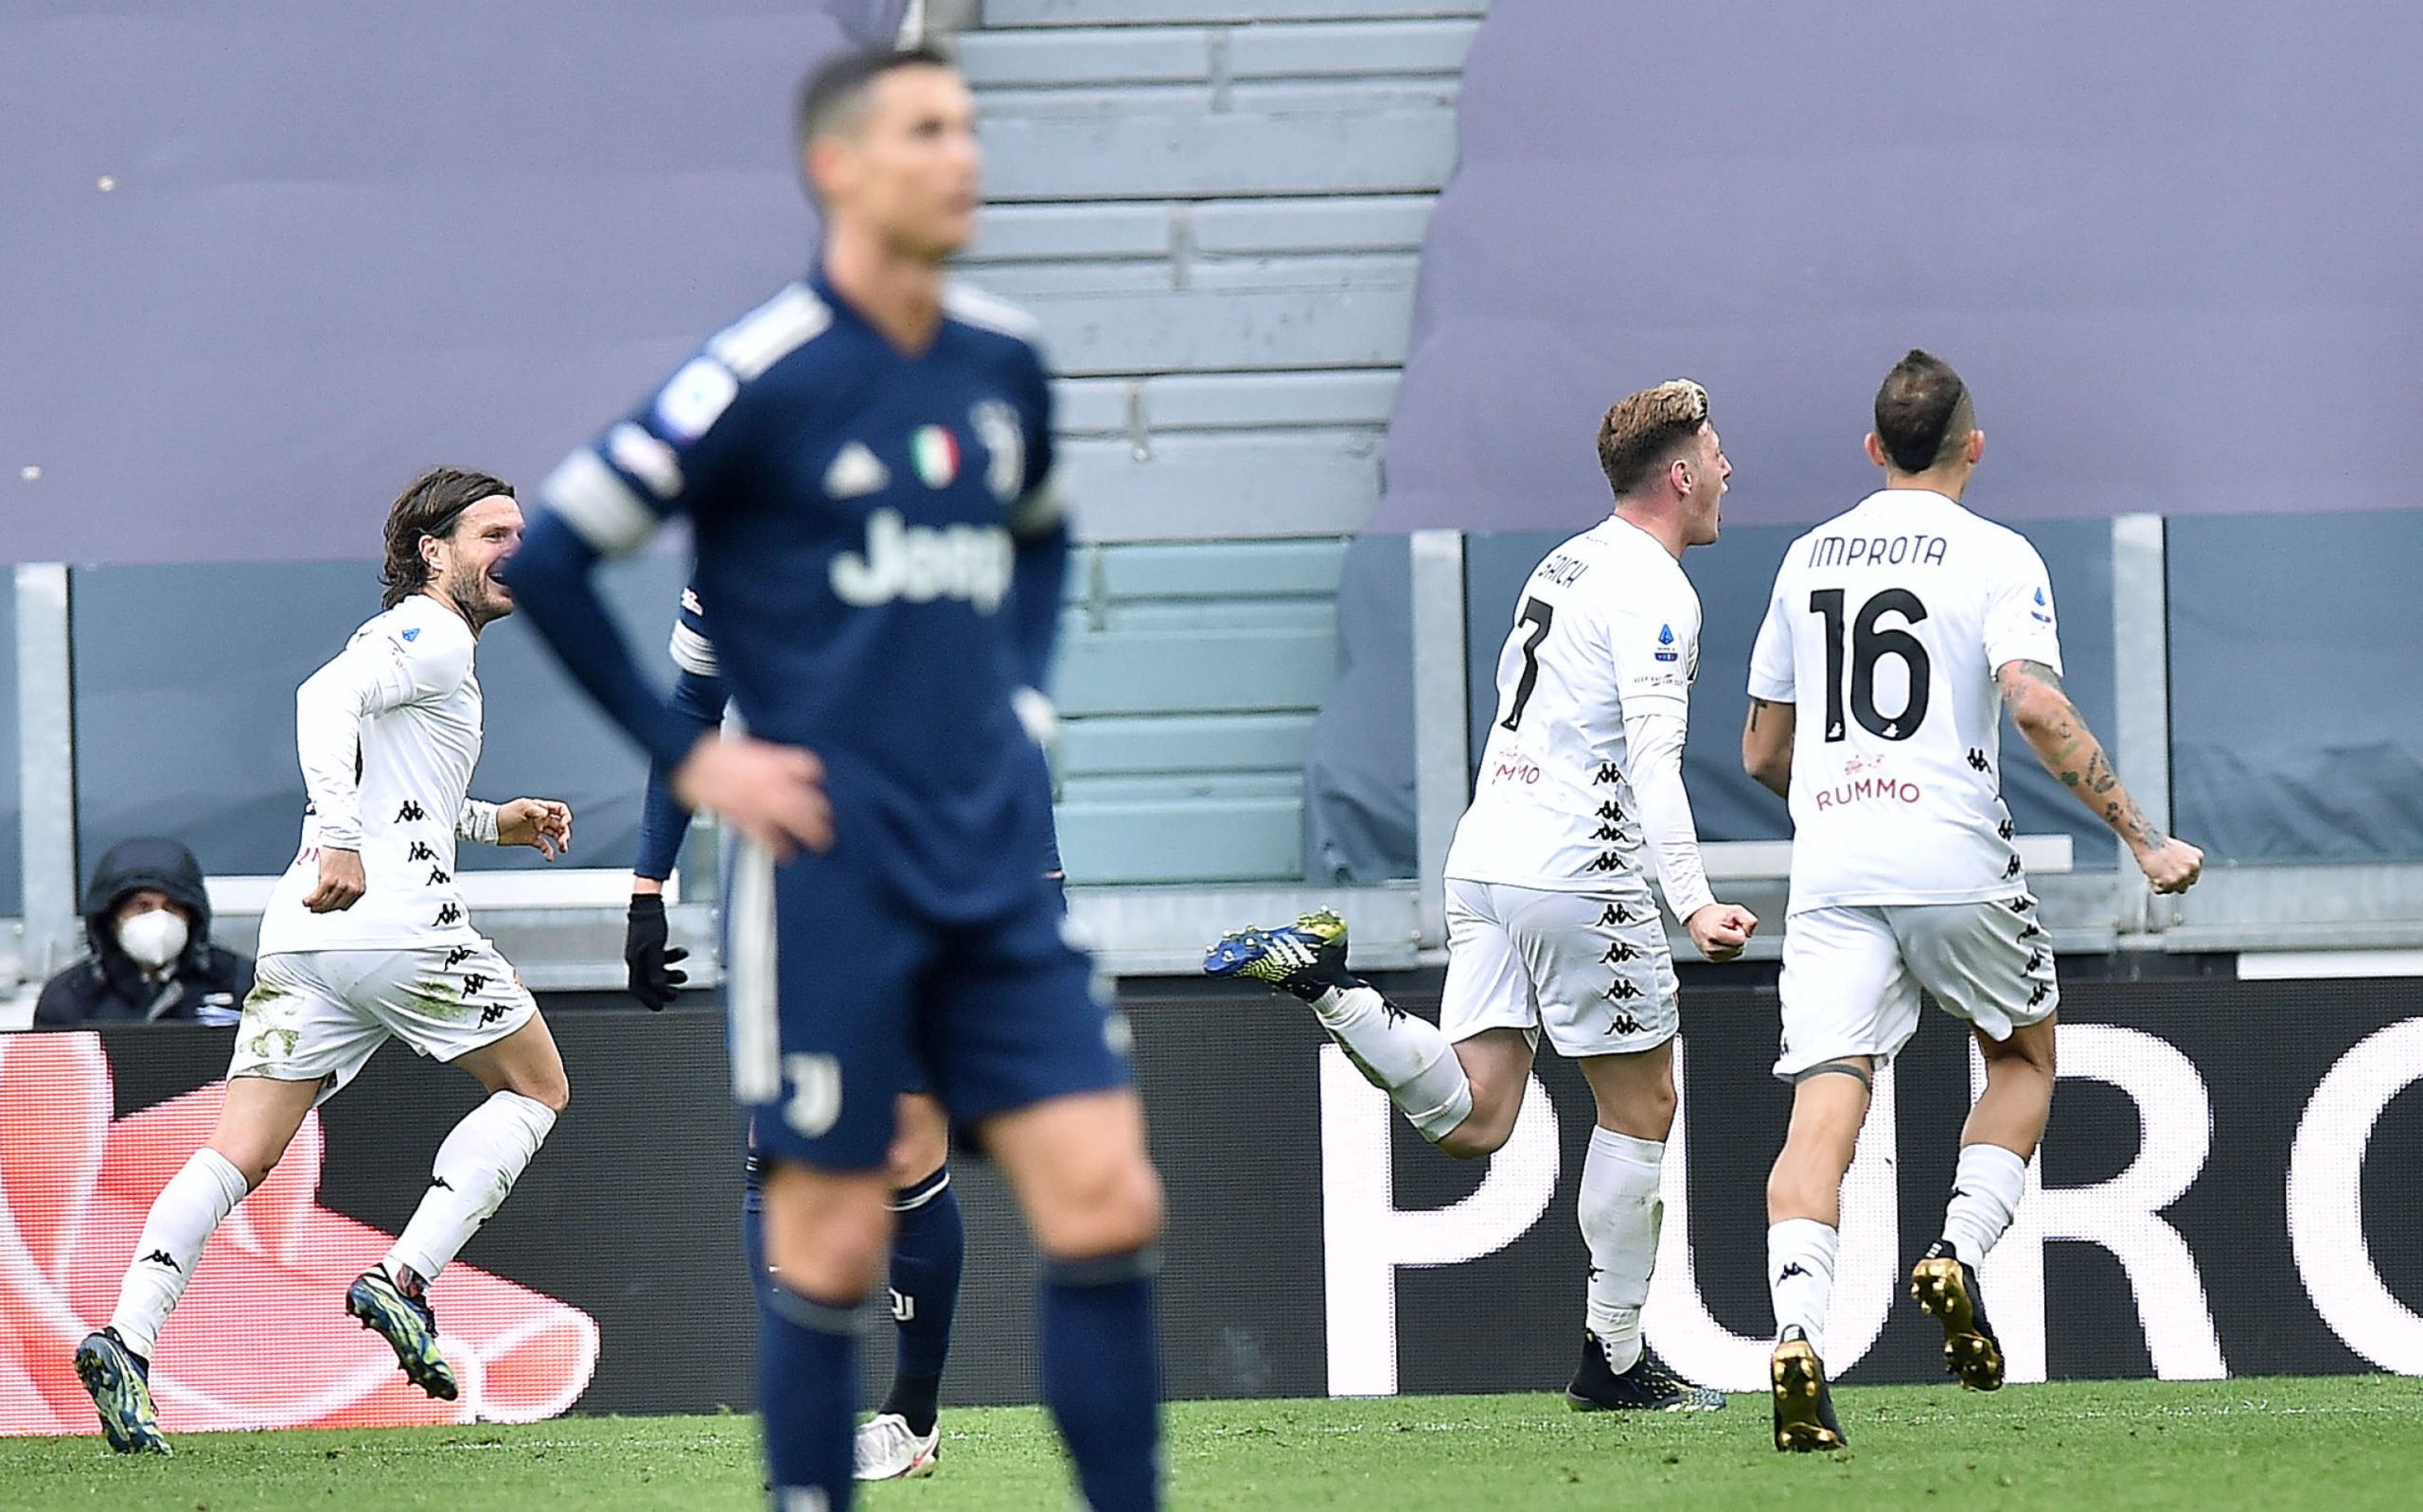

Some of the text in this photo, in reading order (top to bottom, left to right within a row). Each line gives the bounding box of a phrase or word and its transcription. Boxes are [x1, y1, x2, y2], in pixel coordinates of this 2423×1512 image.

[1809, 535, 1947, 569] IMPROTA
[1501, 595, 1553, 731] 7
[1809, 588, 1931, 743] 16
[1815, 778, 1920, 812] RUMMO
